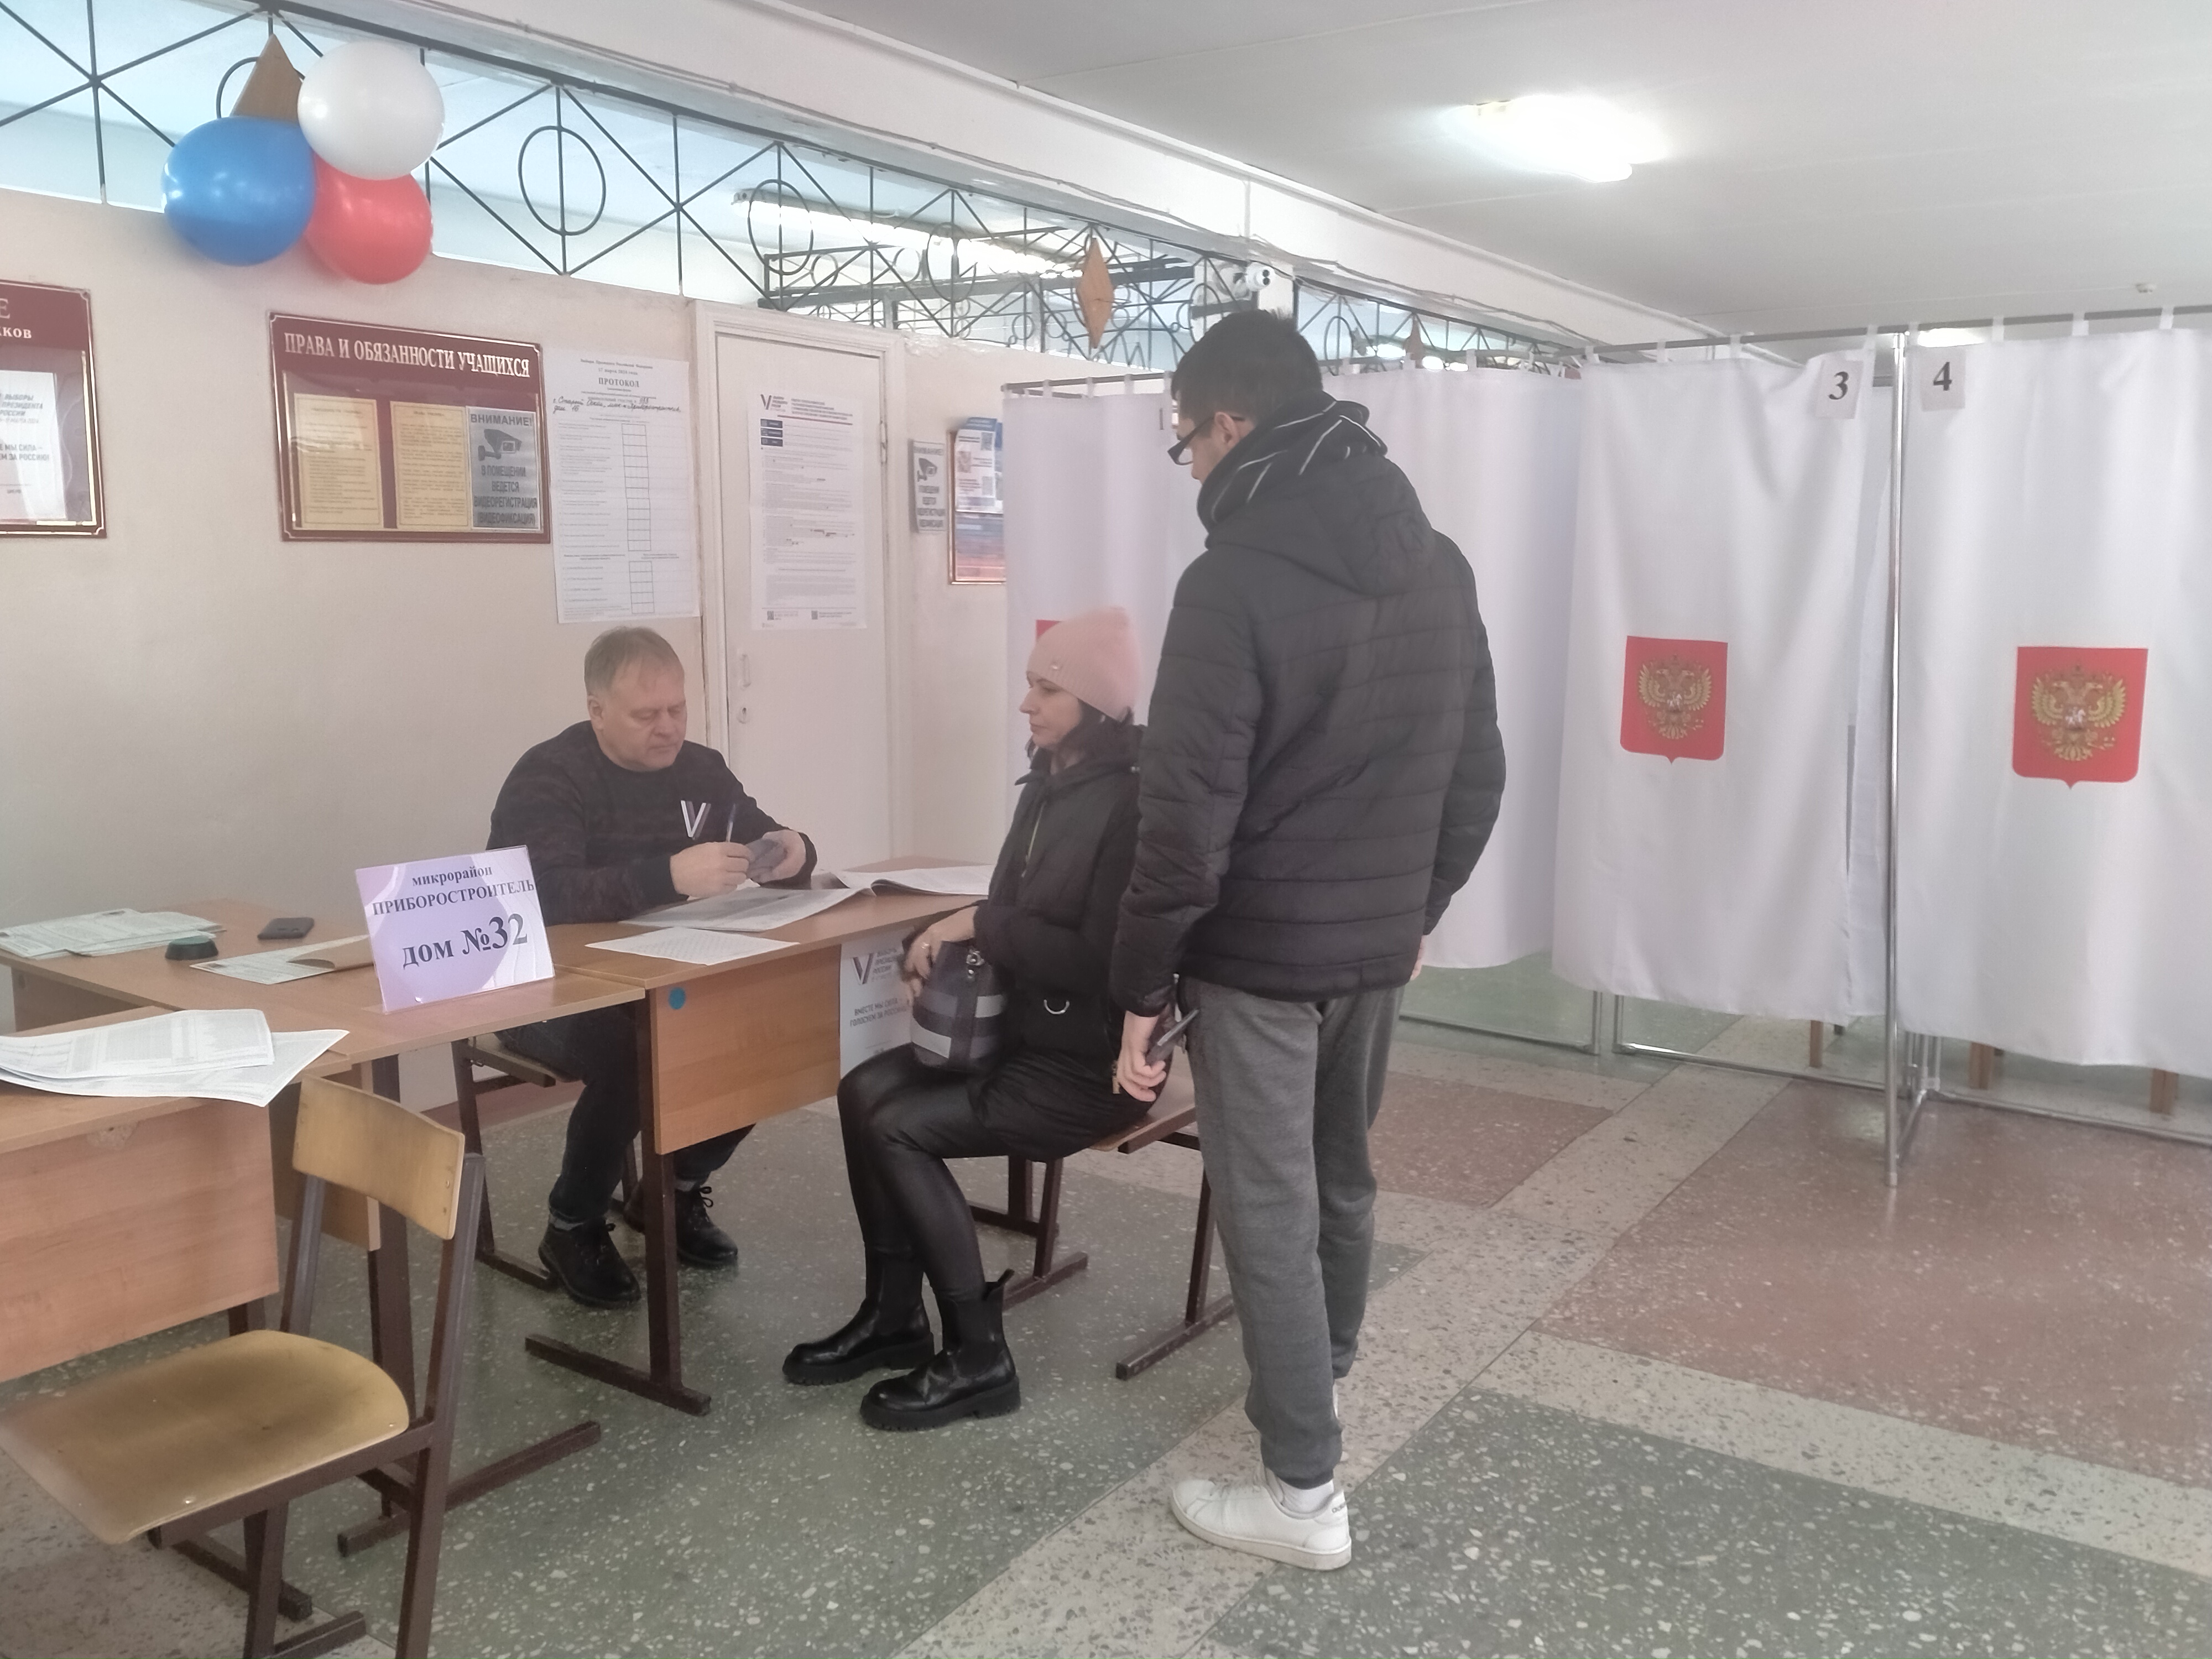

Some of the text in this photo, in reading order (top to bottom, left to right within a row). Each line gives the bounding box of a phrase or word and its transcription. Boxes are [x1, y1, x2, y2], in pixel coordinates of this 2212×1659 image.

[0, 327, 32, 339] КОВ
[284, 332, 530, 377] ПРАВА И ОБЯЗАННОСТИ УЧАЩИХСЯ
[598, 377, 639, 387] ПРОТОКОЛ
[1933, 362, 1953, 391] 4
[1827, 371, 1849, 400] 3
[471, 414, 533, 426] ВНИМАНИЕ!
[481, 465, 526, 478] В ПОМЕЩЕНИИ
[492, 480, 519, 493] ВЕДЕТСЯ
[474, 496, 538, 509] ВИДЕОРЕГИСТРАЦИЯ
[412, 865, 493, 886] микрорайон
[372, 879, 535, 916] ПРИБОРОСТРОИТЕЛЬ
[460, 913, 528, 955] №32
